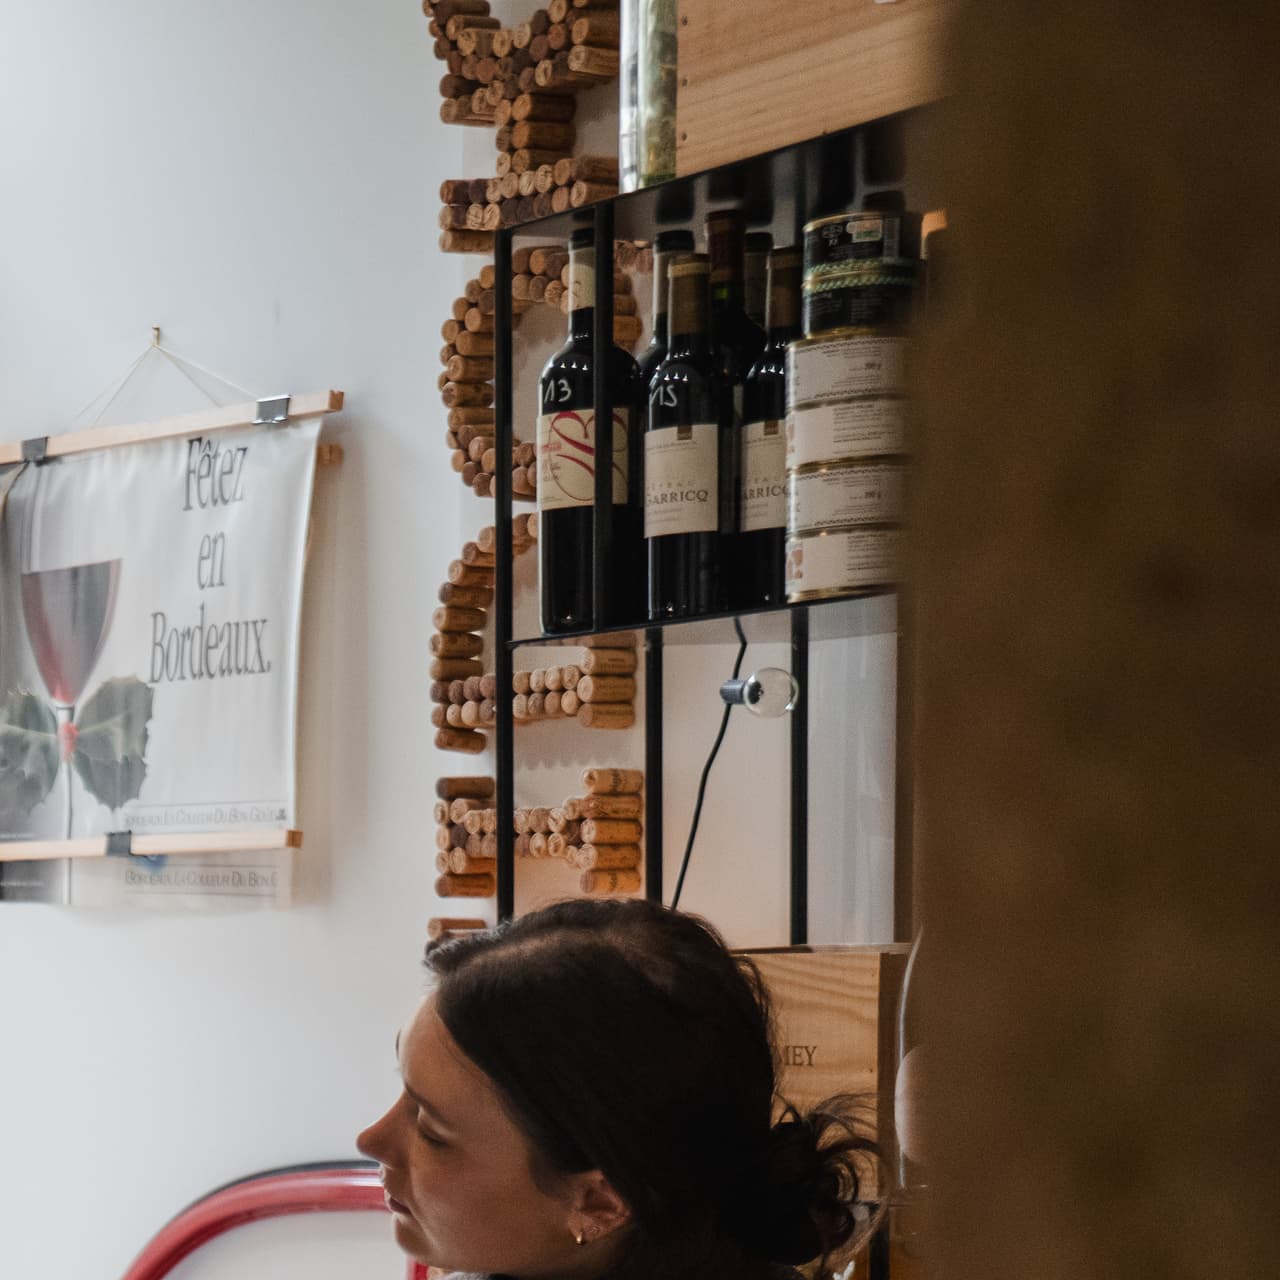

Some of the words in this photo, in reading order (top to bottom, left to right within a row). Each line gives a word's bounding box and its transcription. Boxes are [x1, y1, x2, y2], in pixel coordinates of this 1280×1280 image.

[544, 378, 572, 403] 13
[183, 435, 248, 511] Fêtez
[196, 529, 226, 590] en
[149, 603, 273, 684] Bordeaux.
